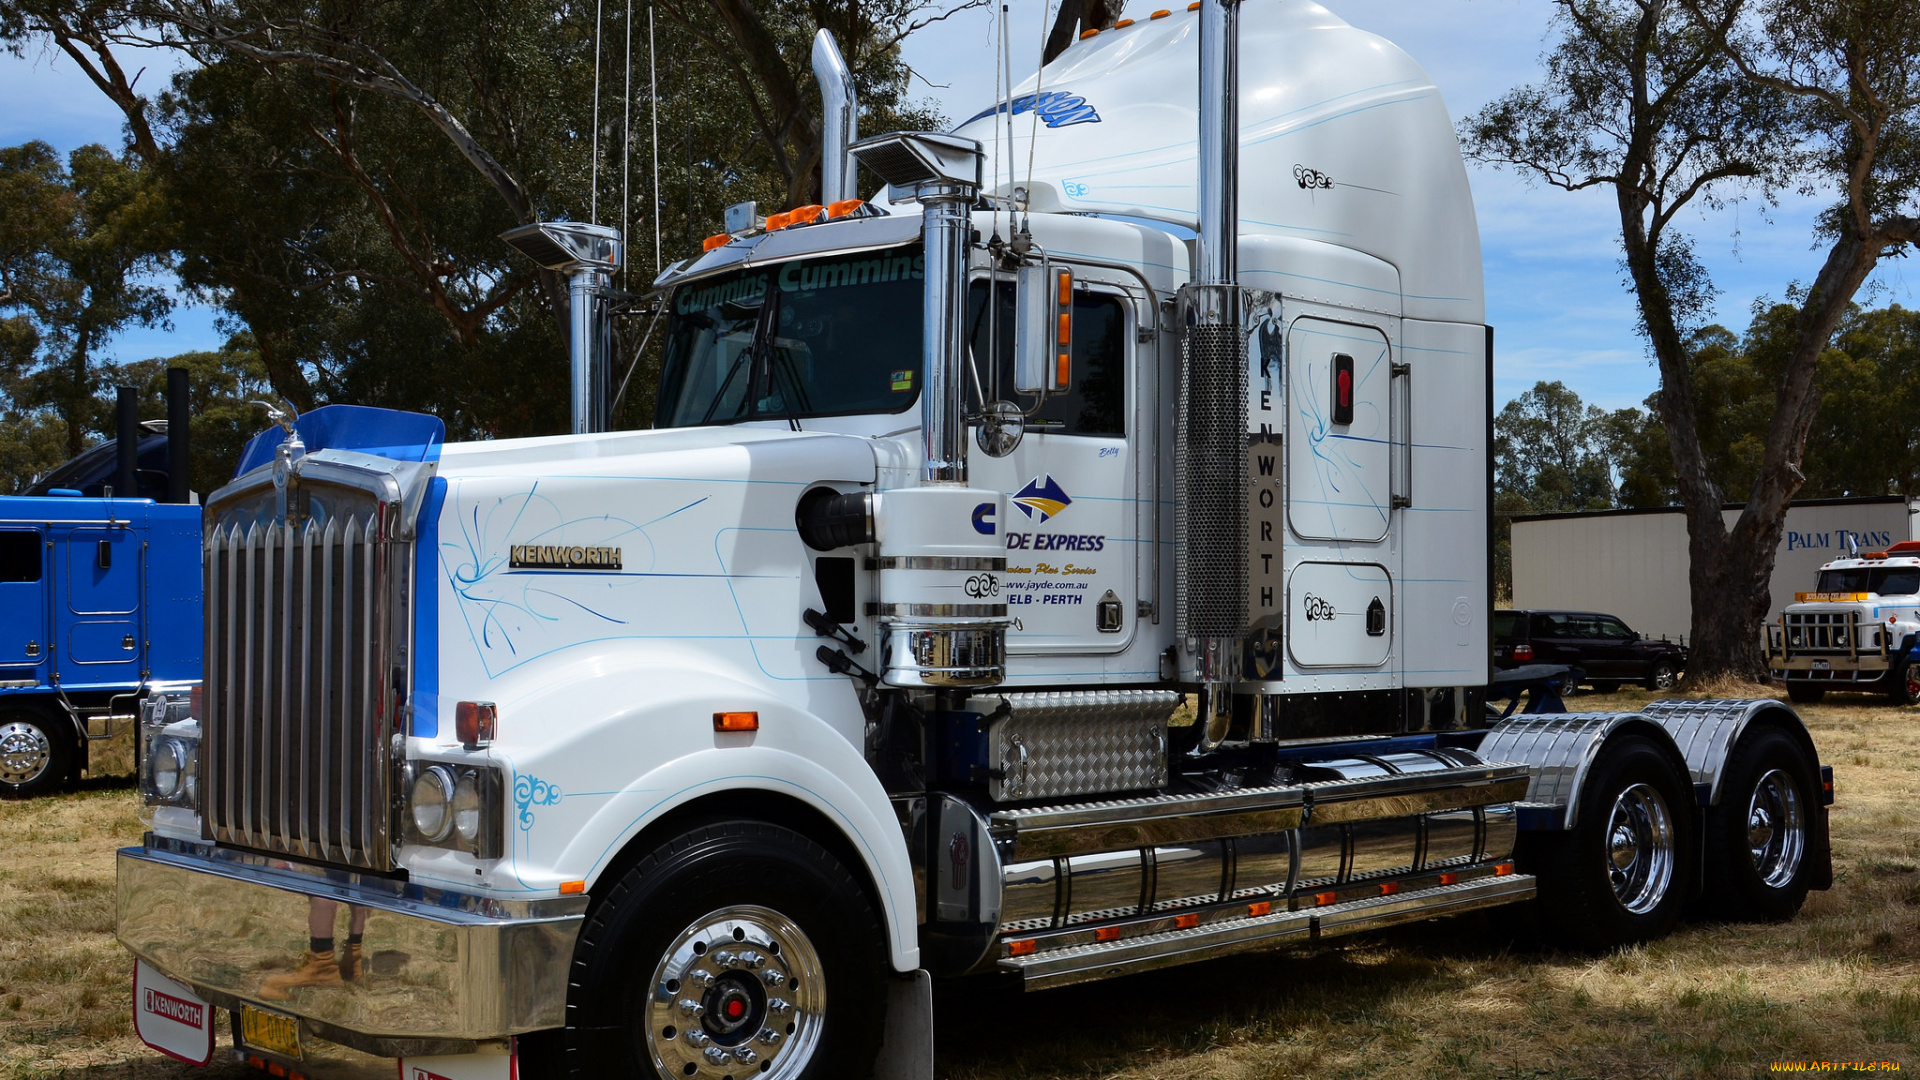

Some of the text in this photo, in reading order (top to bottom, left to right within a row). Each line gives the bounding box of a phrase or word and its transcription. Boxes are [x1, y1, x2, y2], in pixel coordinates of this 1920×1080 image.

[778, 251, 924, 292] Cummins
[677, 272, 769, 316] Cummins
[1257, 357, 1275, 607] KENWORTH
[1033, 533, 1106, 552] EXPRESS
[1787, 531, 1830, 551] PALM
[510, 545, 622, 565] KENWORTH
[1007, 562, 1097, 576] mium Plus Service
[1006, 580, 1088, 591] ww.jayde.com.au
[1006, 594, 1032, 605] ELB
[1043, 594, 1083, 605] PERTH
[154, 995, 201, 1025] KENWORTH
